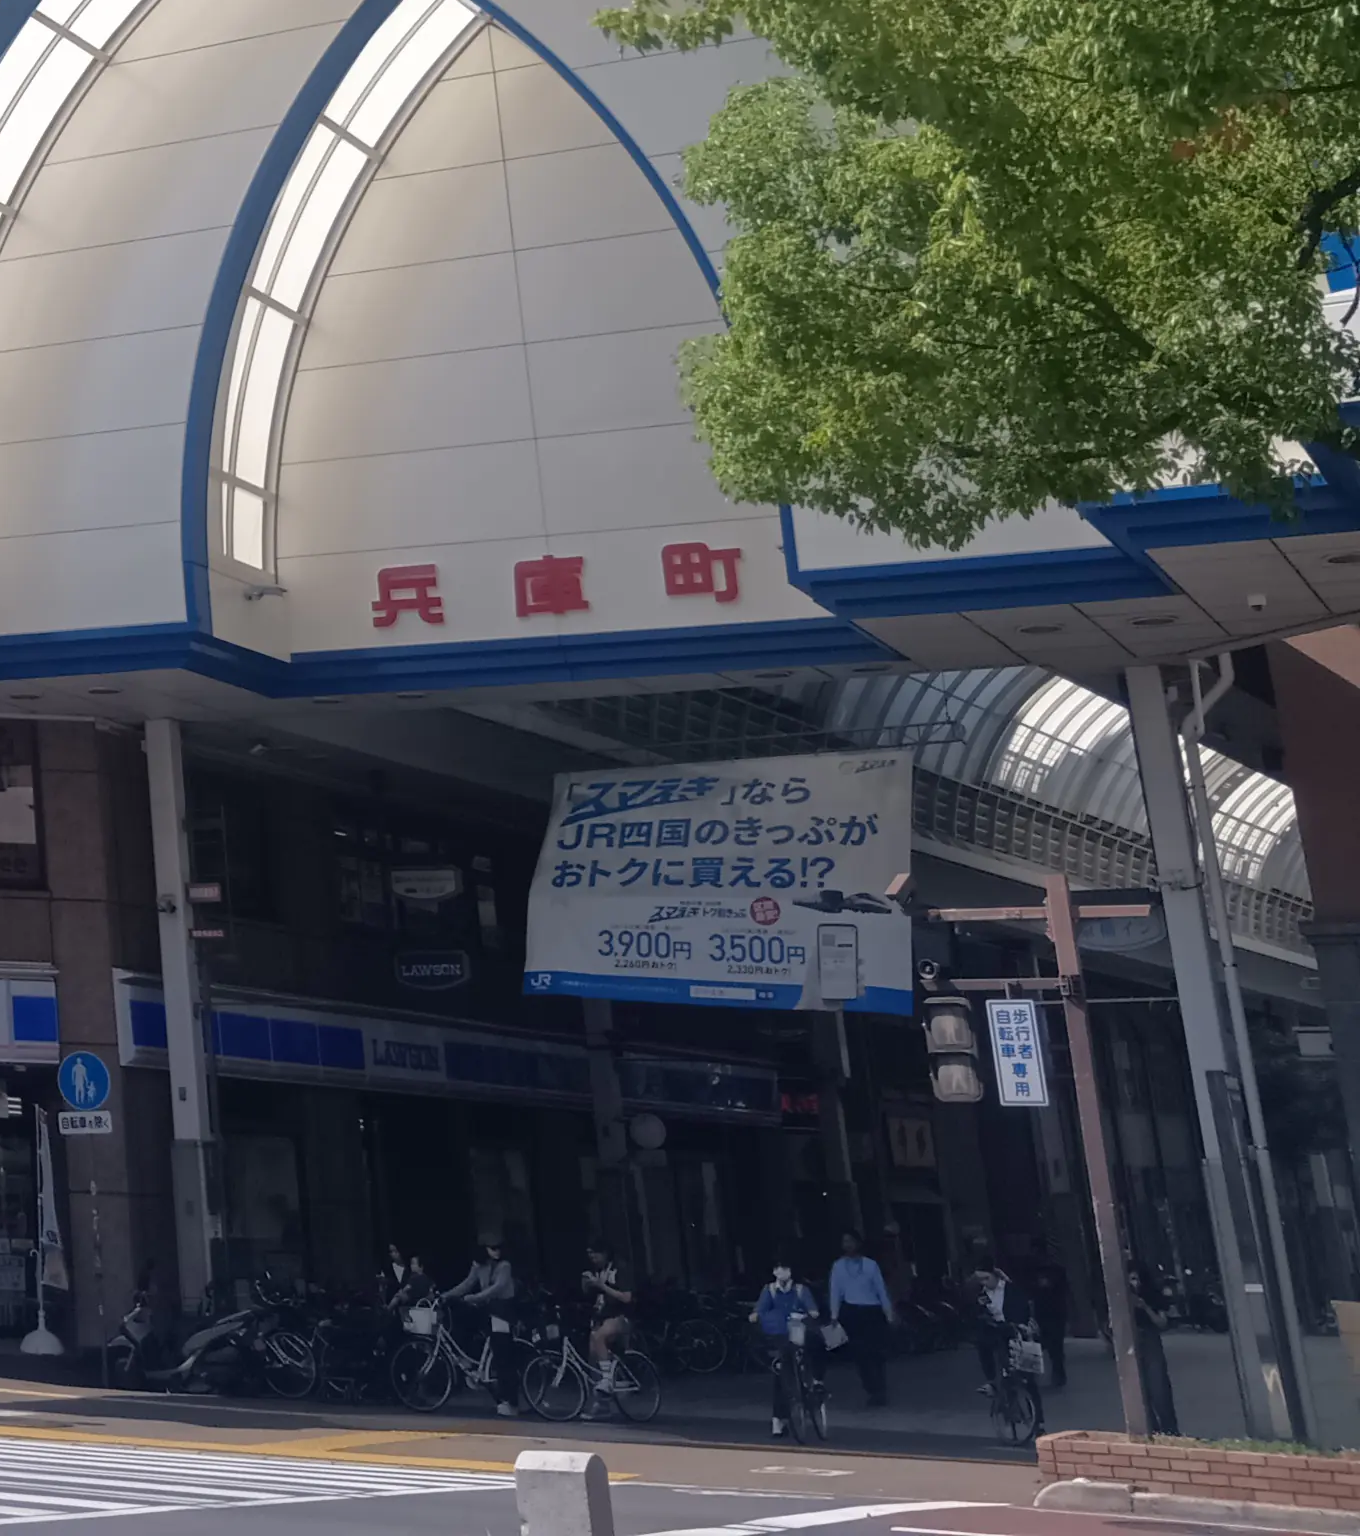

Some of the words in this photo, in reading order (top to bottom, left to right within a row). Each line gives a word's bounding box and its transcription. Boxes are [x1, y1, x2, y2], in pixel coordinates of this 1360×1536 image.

[556, 813, 880, 852] JR四国のきっぷが
[400, 962, 463, 978] LAWSON
[530, 972, 553, 986] JR
[996, 1009, 1017, 1060] 自転車
[1012, 1008, 1033, 1060] 歩行者
[1011, 1061, 1031, 1097] 専用
